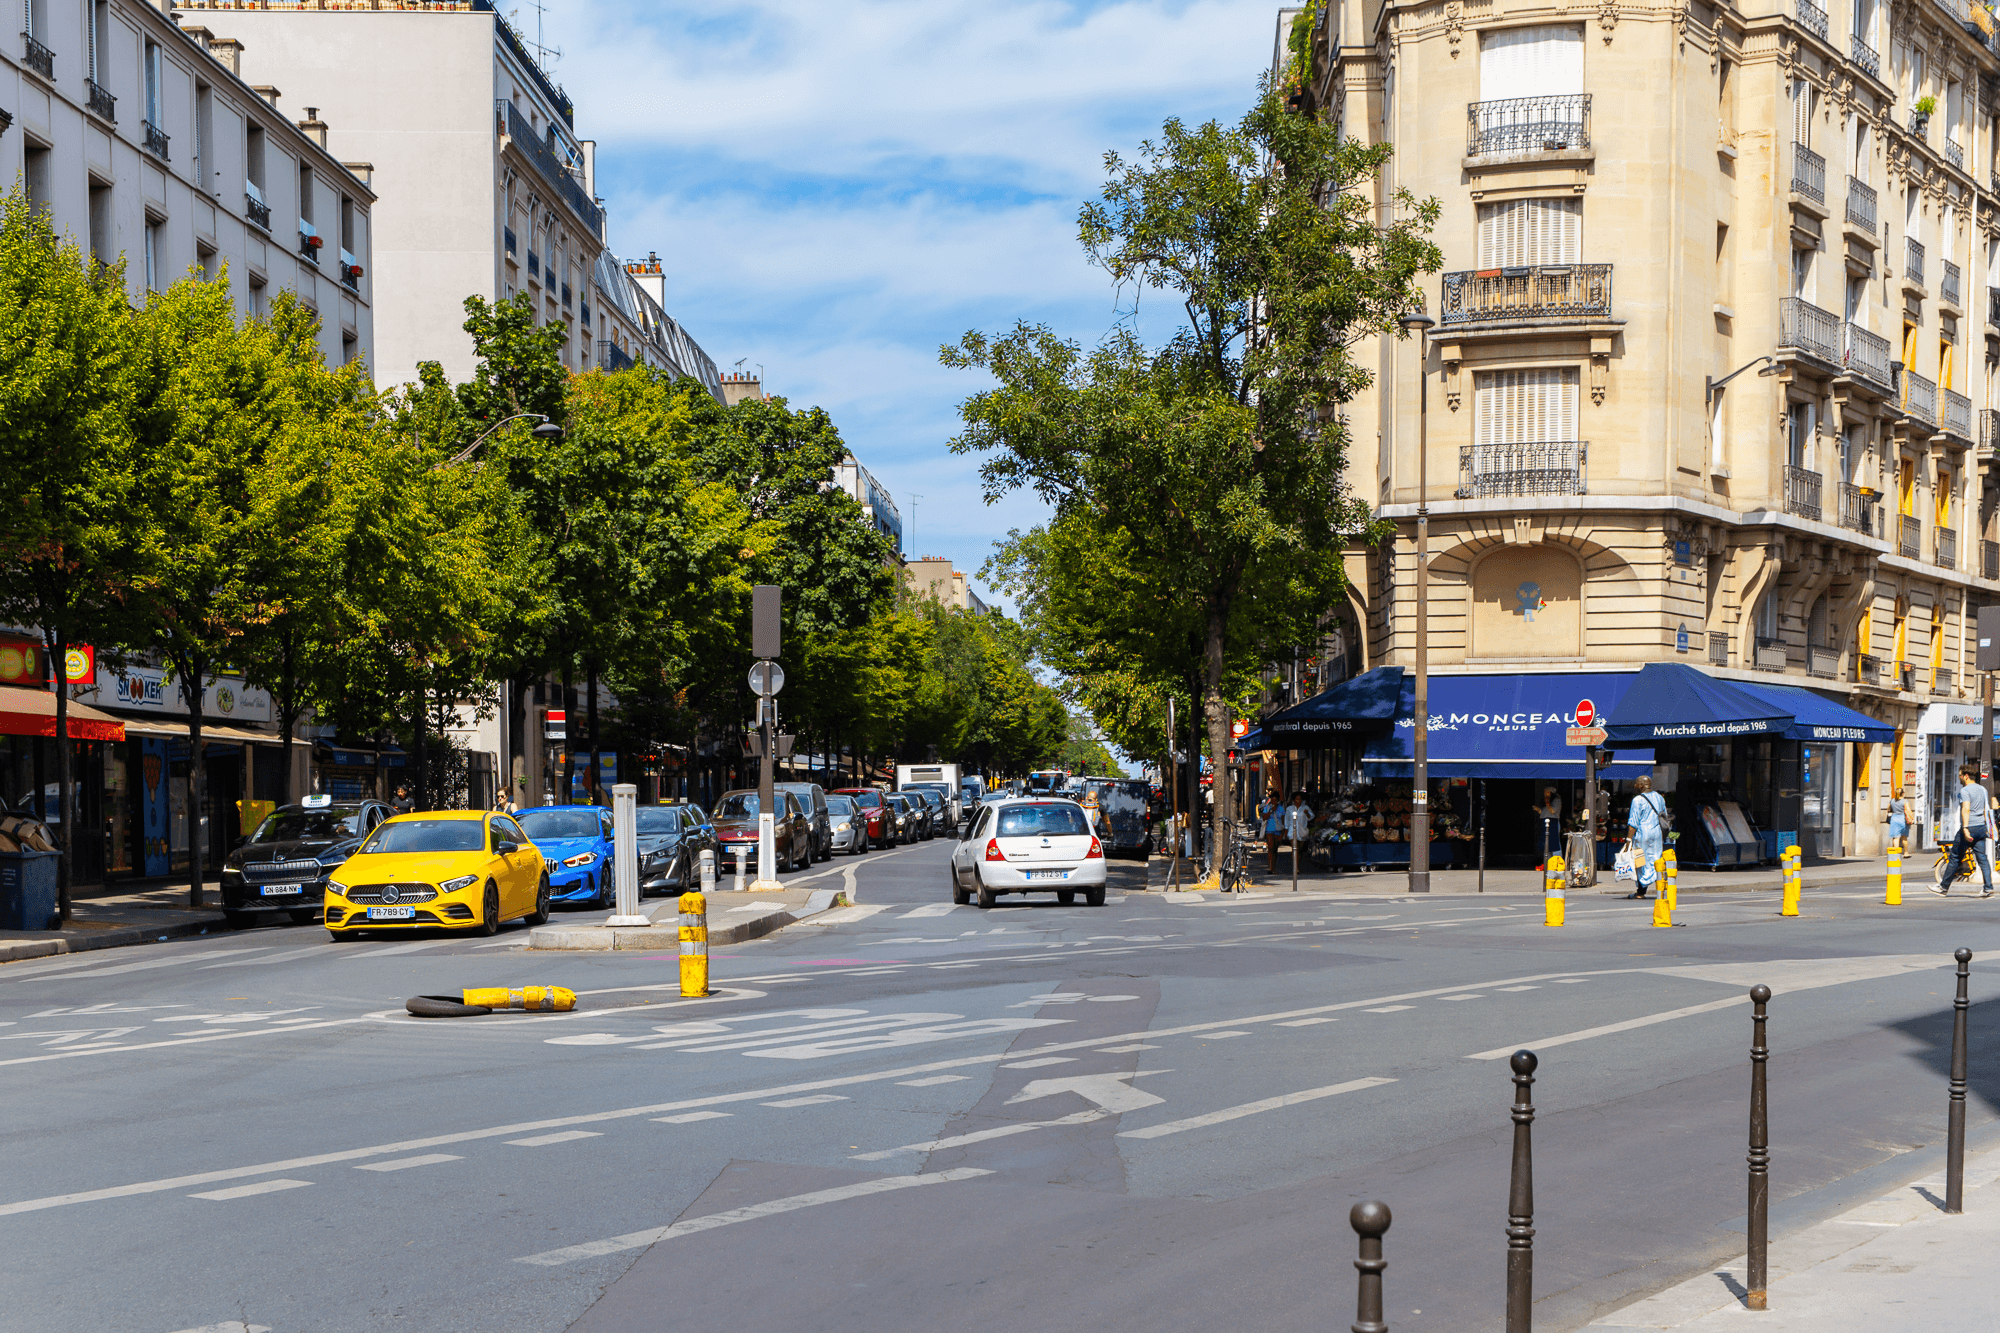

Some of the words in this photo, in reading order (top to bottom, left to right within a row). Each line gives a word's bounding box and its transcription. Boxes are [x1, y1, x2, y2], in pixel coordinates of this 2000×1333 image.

[1449, 712, 1578, 724] MONCEAU
[1302, 721, 1330, 732] depuis
[1332, 721, 1353, 730] 1965
[1488, 724, 1537, 732] FLEURS
[1653, 724, 1696, 736] Marché
[1699, 723, 1726, 734] floral
[1727, 722, 1749, 734] depuis
[1750, 721, 1767, 731] 1965
[1813, 726, 1842, 738] MONCEAU
[1842, 727, 1866, 740] FLEURS
[543, 1009, 1077, 1060] BUS
